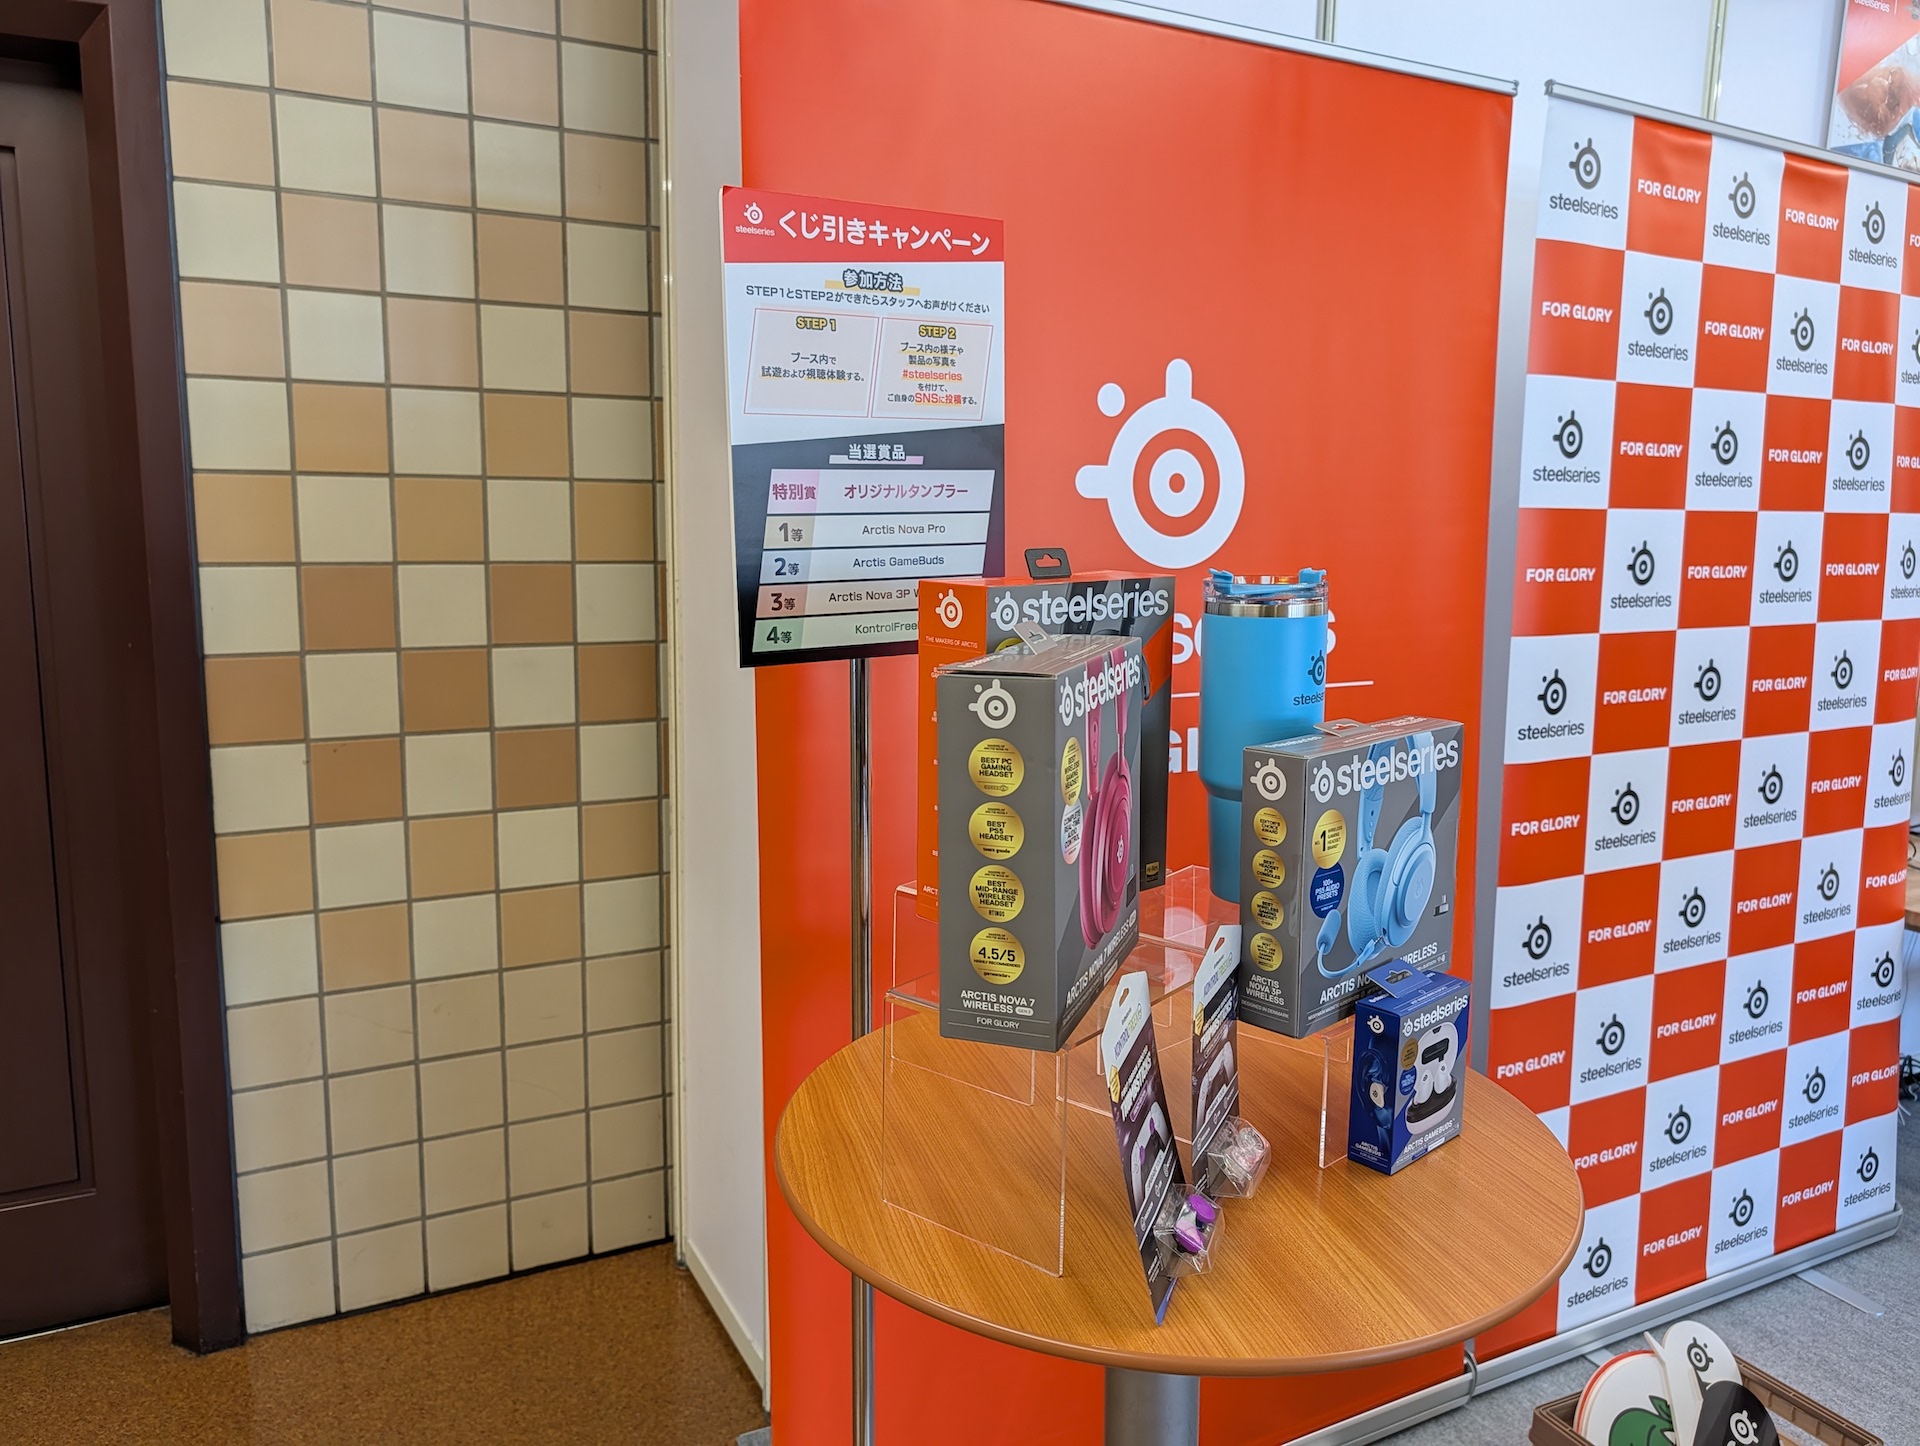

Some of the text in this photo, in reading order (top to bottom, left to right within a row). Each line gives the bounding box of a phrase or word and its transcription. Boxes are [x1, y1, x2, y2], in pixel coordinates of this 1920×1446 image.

[1637, 179, 1701, 204] FOR GLORY
[1550, 193, 1619, 219] steelseries
[1785, 208, 1839, 231] FOR GLORY
[735, 225, 775, 237] steelseries
[778, 209, 991, 256] くじ引きキャンペーン
[1713, 223, 1770, 245] steelseries
[1849, 248, 1897, 268] steelseries
[842, 269, 904, 293] 参加方法
[746, 285, 990, 314] STEP1とSTEP2ができたらスタッフへお声がけください
[1542, 301, 1613, 323] FOR GLORY
[796, 316, 836, 331] STEP 1
[919, 325, 956, 339] STEP 2
[900, 342, 964, 355] ブース内の様子や
[1628, 341, 1688, 361] steelseries
[1842, 338, 1893, 355] FOR GLORY
[791, 352, 837, 365] ブース内で
[908, 355, 956, 367] 製品の写真を
[1776, 358, 1828, 374] steelseries
[761, 366, 864, 382] 試遊および視聴体験する。
[902, 369, 962, 381] #steelseries
[918, 383, 948, 392] を付けて、
[887, 393, 978, 405] ご自身のSNSに投稿する。
[848, 443, 906, 461] 当選賞品
[1620, 441, 1683, 458] FOR GLORY
[1768, 449, 1822, 464] FOR GLORY
[1896, 456, 1910, 468] FOR
[1533, 466, 1600, 483] steelseries
[1695, 472, 1752, 488] steelseries
[772, 483, 968, 500] 特別賞 オリジナルタンブラー
[1832, 478, 1885, 491] steelseries
[779, 522, 945, 542] 1等 Arctis Nova Pro
[774, 555, 944, 576] 2等 Arctis GameBuds
[1688, 565, 1748, 579] FOR GLORY
[1826, 563, 1879, 576] FOR GLORY
[1526, 568, 1596, 583] FOR GLORY
[771, 592, 796, 611] 3等
[829, 591, 862, 602] Arctis
[866, 590, 893, 600] Nova
[896, 589, 911, 599] 3P
[1022, 583, 1169, 626] steelseries
[1610, 592, 1672, 609] steelseries
[1759, 588, 1812, 604] steelseries
[766, 622, 918, 644] 4等 KontrolFree
[935, 637, 953, 645] MAKERS
[1884, 666, 1919, 682] FOR GLORY
[1074, 651, 1140, 718] steelseries
[1752, 676, 1807, 692] FOR GLORY
[1293, 692, 1324, 706] steelse
[1817, 694, 1867, 712] steelseries
[1679, 706, 1736, 725] steelseries
[1518, 720, 1585, 741] steelseries
[979, 770, 1014, 778] HEADSET
[1337, 739, 1459, 796] steelseries
[1811, 775, 1861, 794] FOR GLORY
[1672, 793, 1732, 814] FOR GLORY
[1874, 789, 1910, 808] steelseries
[1511, 814, 1580, 836] FOR GLORY
[1743, 808, 1797, 828] steelseries
[979, 833, 1014, 841] HEADSET
[1321, 830, 1326, 851] 1
[1595, 829, 1656, 851] steelseries
[976, 885, 1018, 895] MID-RANGE
[978, 892, 1016, 901] WIRELESS
[980, 899, 1014, 907] HEADSET
[1737, 892, 1792, 914] FOR GLORY
[1803, 904, 1851, 925] steelseries
[1663, 931, 1721, 954] steelseries
[979, 947, 1015, 962] 4.5/5
[1066, 971, 1088, 1008] ARCTIS
[1089, 953, 1104, 981] NOVA
[1107, 919, 1129, 957] WIRELESS
[1251, 974, 1279, 989] ARCTIS
[1503, 962, 1570, 988] steelseries
[1246, 987, 1284, 1005] WIRELESS
[1249, 981, 1282, 996] NOVA 3P
[1320, 978, 1355, 1004] ARCTIS
[1796, 980, 1847, 1004] FOR GLORY
[960, 989, 1035, 1008] ARCTIS NOVA 7
[962, 999, 1013, 1014] WIRELESS
[977, 1017, 1020, 1029] FOR GLORY
[1414, 995, 1468, 1032] steelseries
[1657, 1013, 1717, 1039] FOR GLORY
[1729, 1020, 1783, 1045] steelseries
[1497, 1050, 1566, 1079] FOR GLORY
[1580, 1057, 1642, 1084] steelseries
[1852, 1063, 1898, 1087] FOR GLORY
[1788, 1104, 1839, 1130] steelseries
[1403, 1120, 1453, 1154] ARCTIS GAMEBUDS
[1574, 1141, 1637, 1170] FOR GLORY
[1649, 1145, 1707, 1173] steelseries
[1782, 1180, 1834, 1208] FOR GLORY
[1844, 1182, 1891, 1207] steelseries
[1643, 1226, 1702, 1256] FOR GLORY
[1714, 1225, 1767, 1254] steelseries
[1567, 1276, 1628, 1308] steelseries
